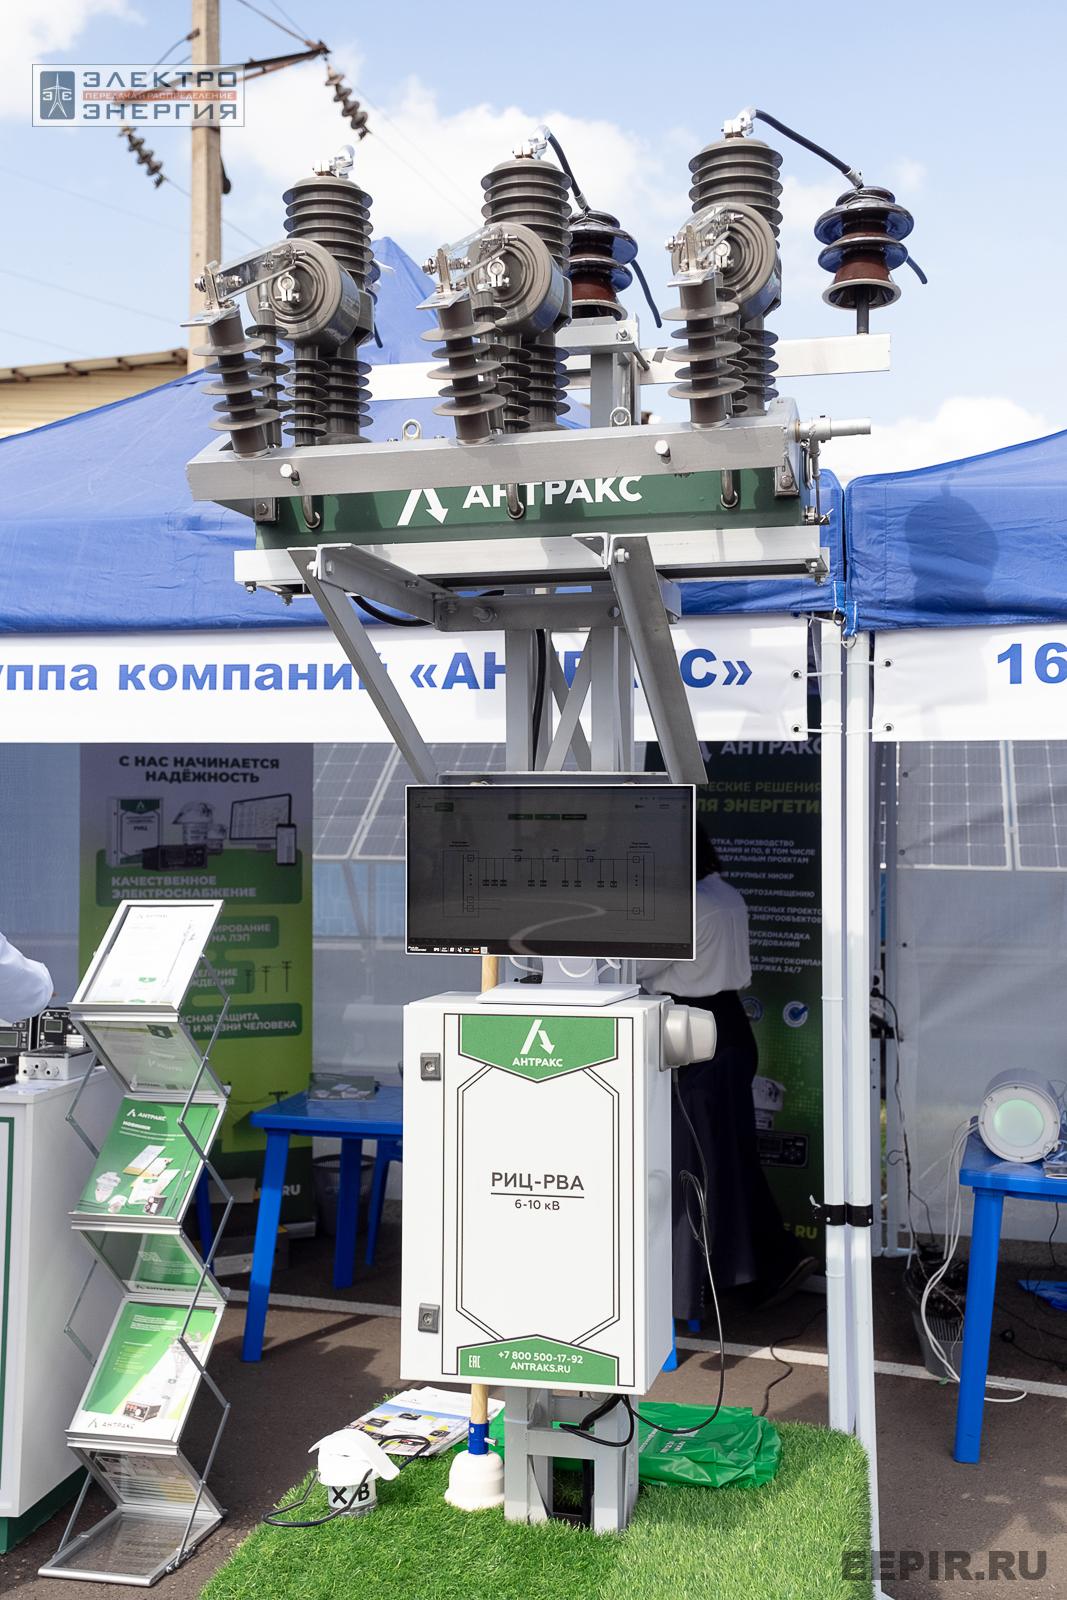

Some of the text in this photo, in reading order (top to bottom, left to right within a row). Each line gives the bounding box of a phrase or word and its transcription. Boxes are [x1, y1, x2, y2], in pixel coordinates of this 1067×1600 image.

[997, 642, 1067, 685] 16
[0, 663, 98, 691] ппа
[119, 756, 280, 769] С НАС НАЧИНАЕТСЯ
[145, 769, 260, 783] НАДЁЖНОСТЬ
[111, 876, 217, 887] КАЧЕСТВЕННОЕ
[111, 887, 257, 899] ЭЛЕКТРОСНАБЖЕНИЕ
[512, 1057, 563, 1068] АНТРАКС
[491, 1171, 585, 1191] РИЦ-РВА
[514, 1199, 560, 1211] 6-10 кВ
[498, 1351, 584, 1364] +7 800 500-17-92
[510, 1362, 571, 1374] ANTRAKS.RU
